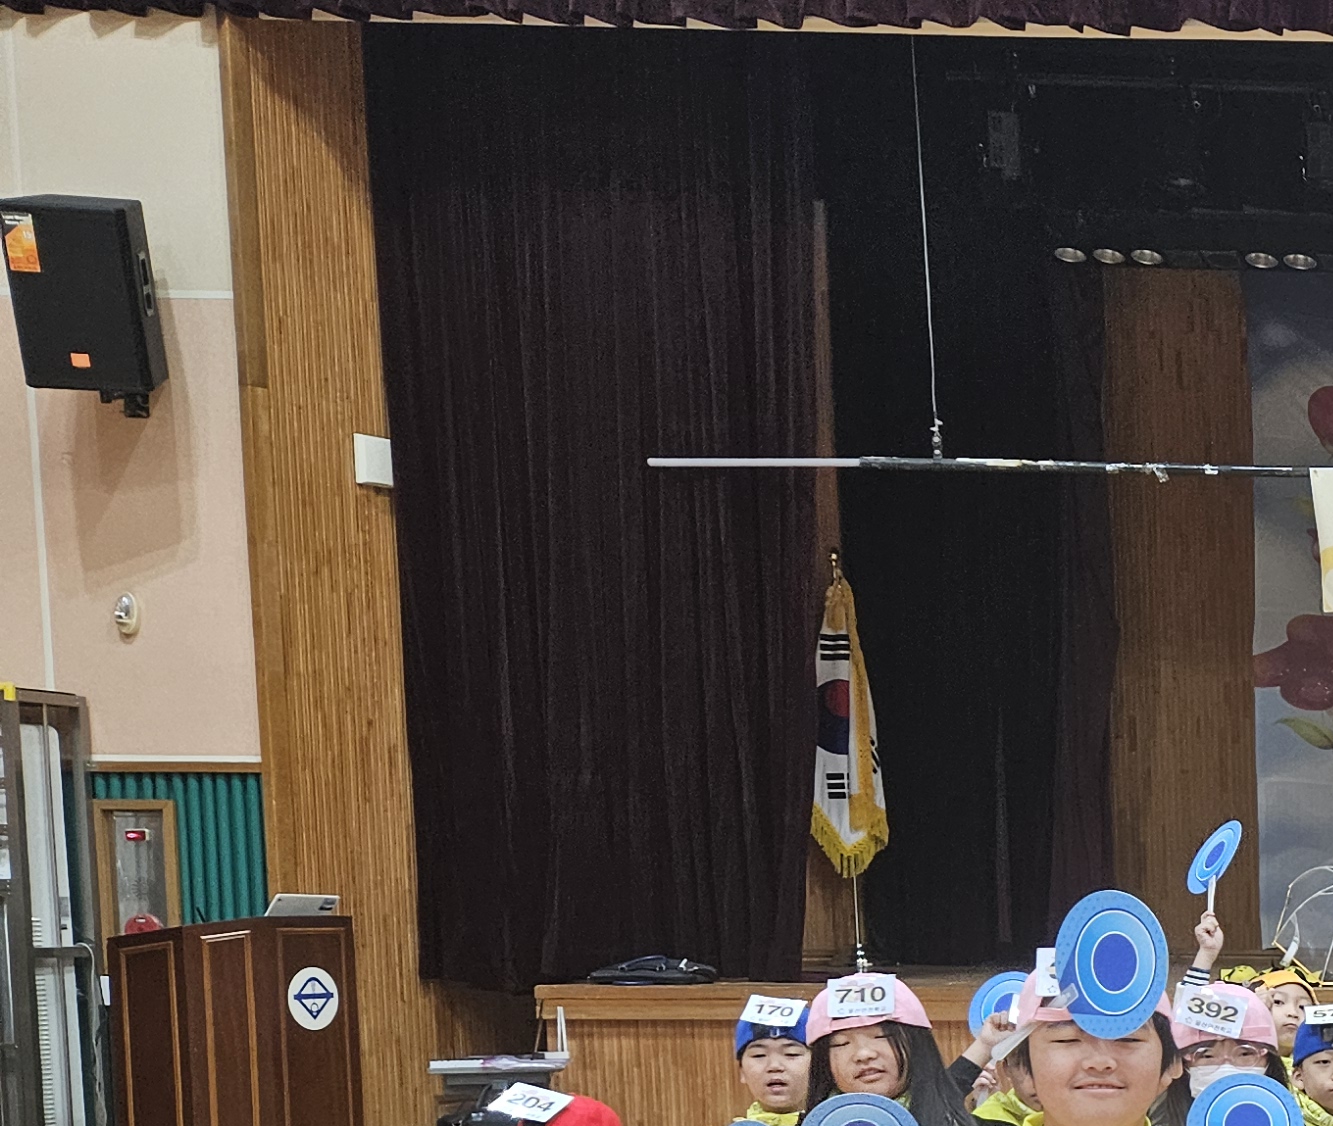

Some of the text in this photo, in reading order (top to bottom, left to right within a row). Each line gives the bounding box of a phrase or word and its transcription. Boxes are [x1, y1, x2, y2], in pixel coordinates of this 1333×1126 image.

[835, 985, 886, 1004] 710
[754, 1003, 794, 1017] 170
[1187, 996, 1239, 1024] 392
[507, 1093, 556, 1113] 204
